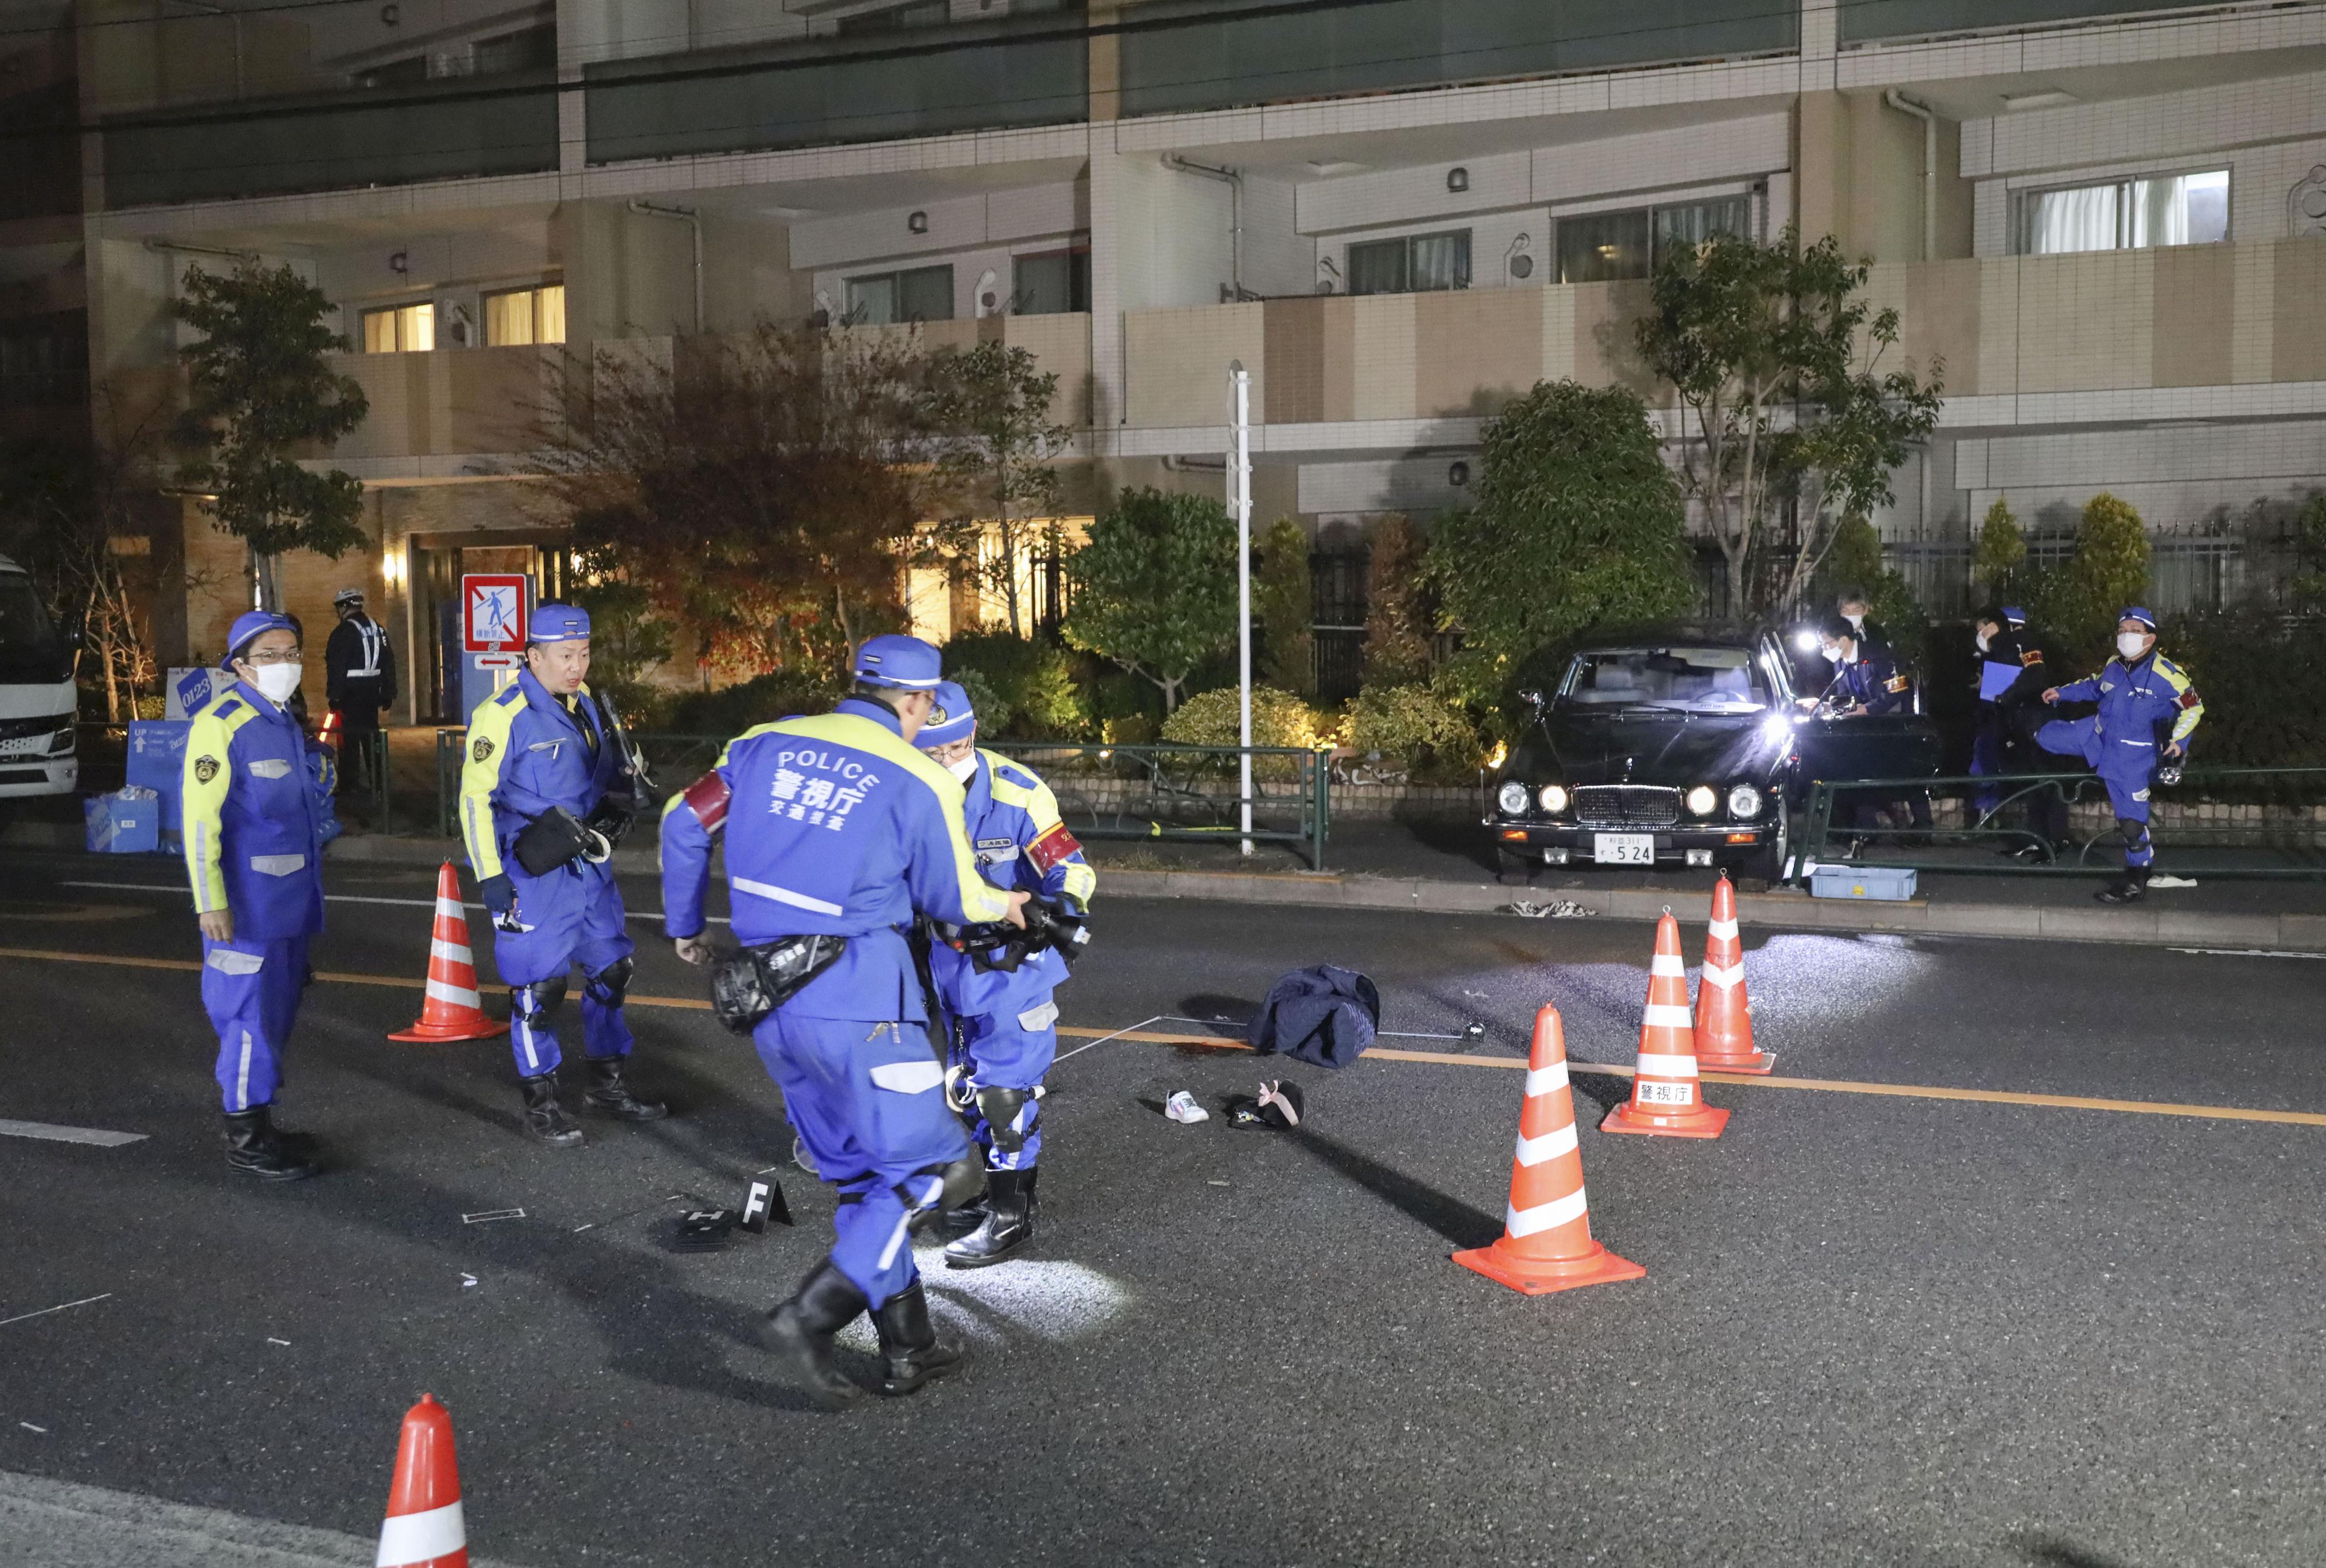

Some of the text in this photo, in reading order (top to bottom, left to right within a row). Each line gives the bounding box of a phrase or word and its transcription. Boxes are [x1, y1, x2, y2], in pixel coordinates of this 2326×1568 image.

[476, 628, 505, 639] 横断禁止
[182, 678, 211, 707] 0123
[134, 729, 147, 737] UP
[778, 750, 880, 792] POLICE
[770, 768, 865, 815] 警視庁
[1641, 1084, 1688, 1101] 警視庁
[742, 1182, 769, 1224] F
